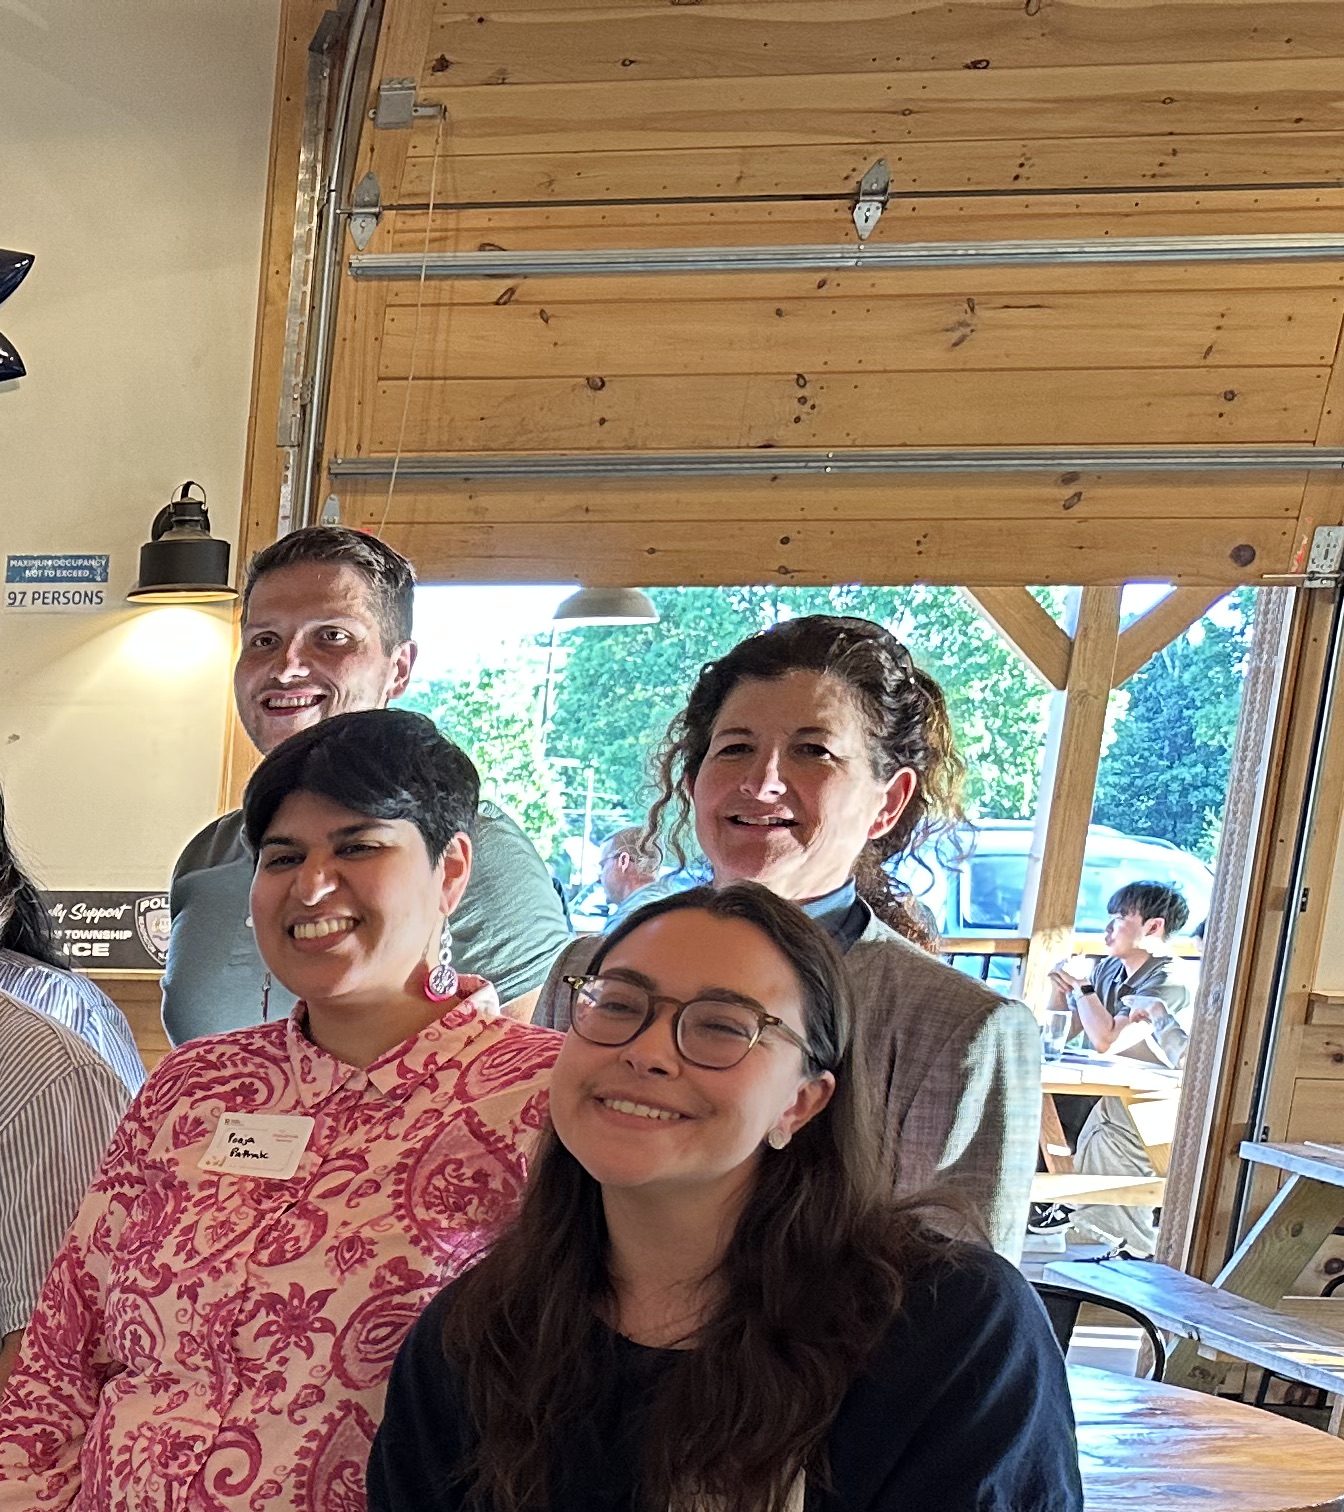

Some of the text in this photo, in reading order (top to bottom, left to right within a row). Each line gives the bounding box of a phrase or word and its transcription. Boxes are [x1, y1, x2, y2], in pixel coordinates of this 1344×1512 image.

[10, 559, 107, 567] MAXIMUM OCCUPANCY
[7, 590, 104, 606] 97 PERSONS
[68, 903, 132, 924] Support
[64, 930, 133, 940] TOWNSHIP
